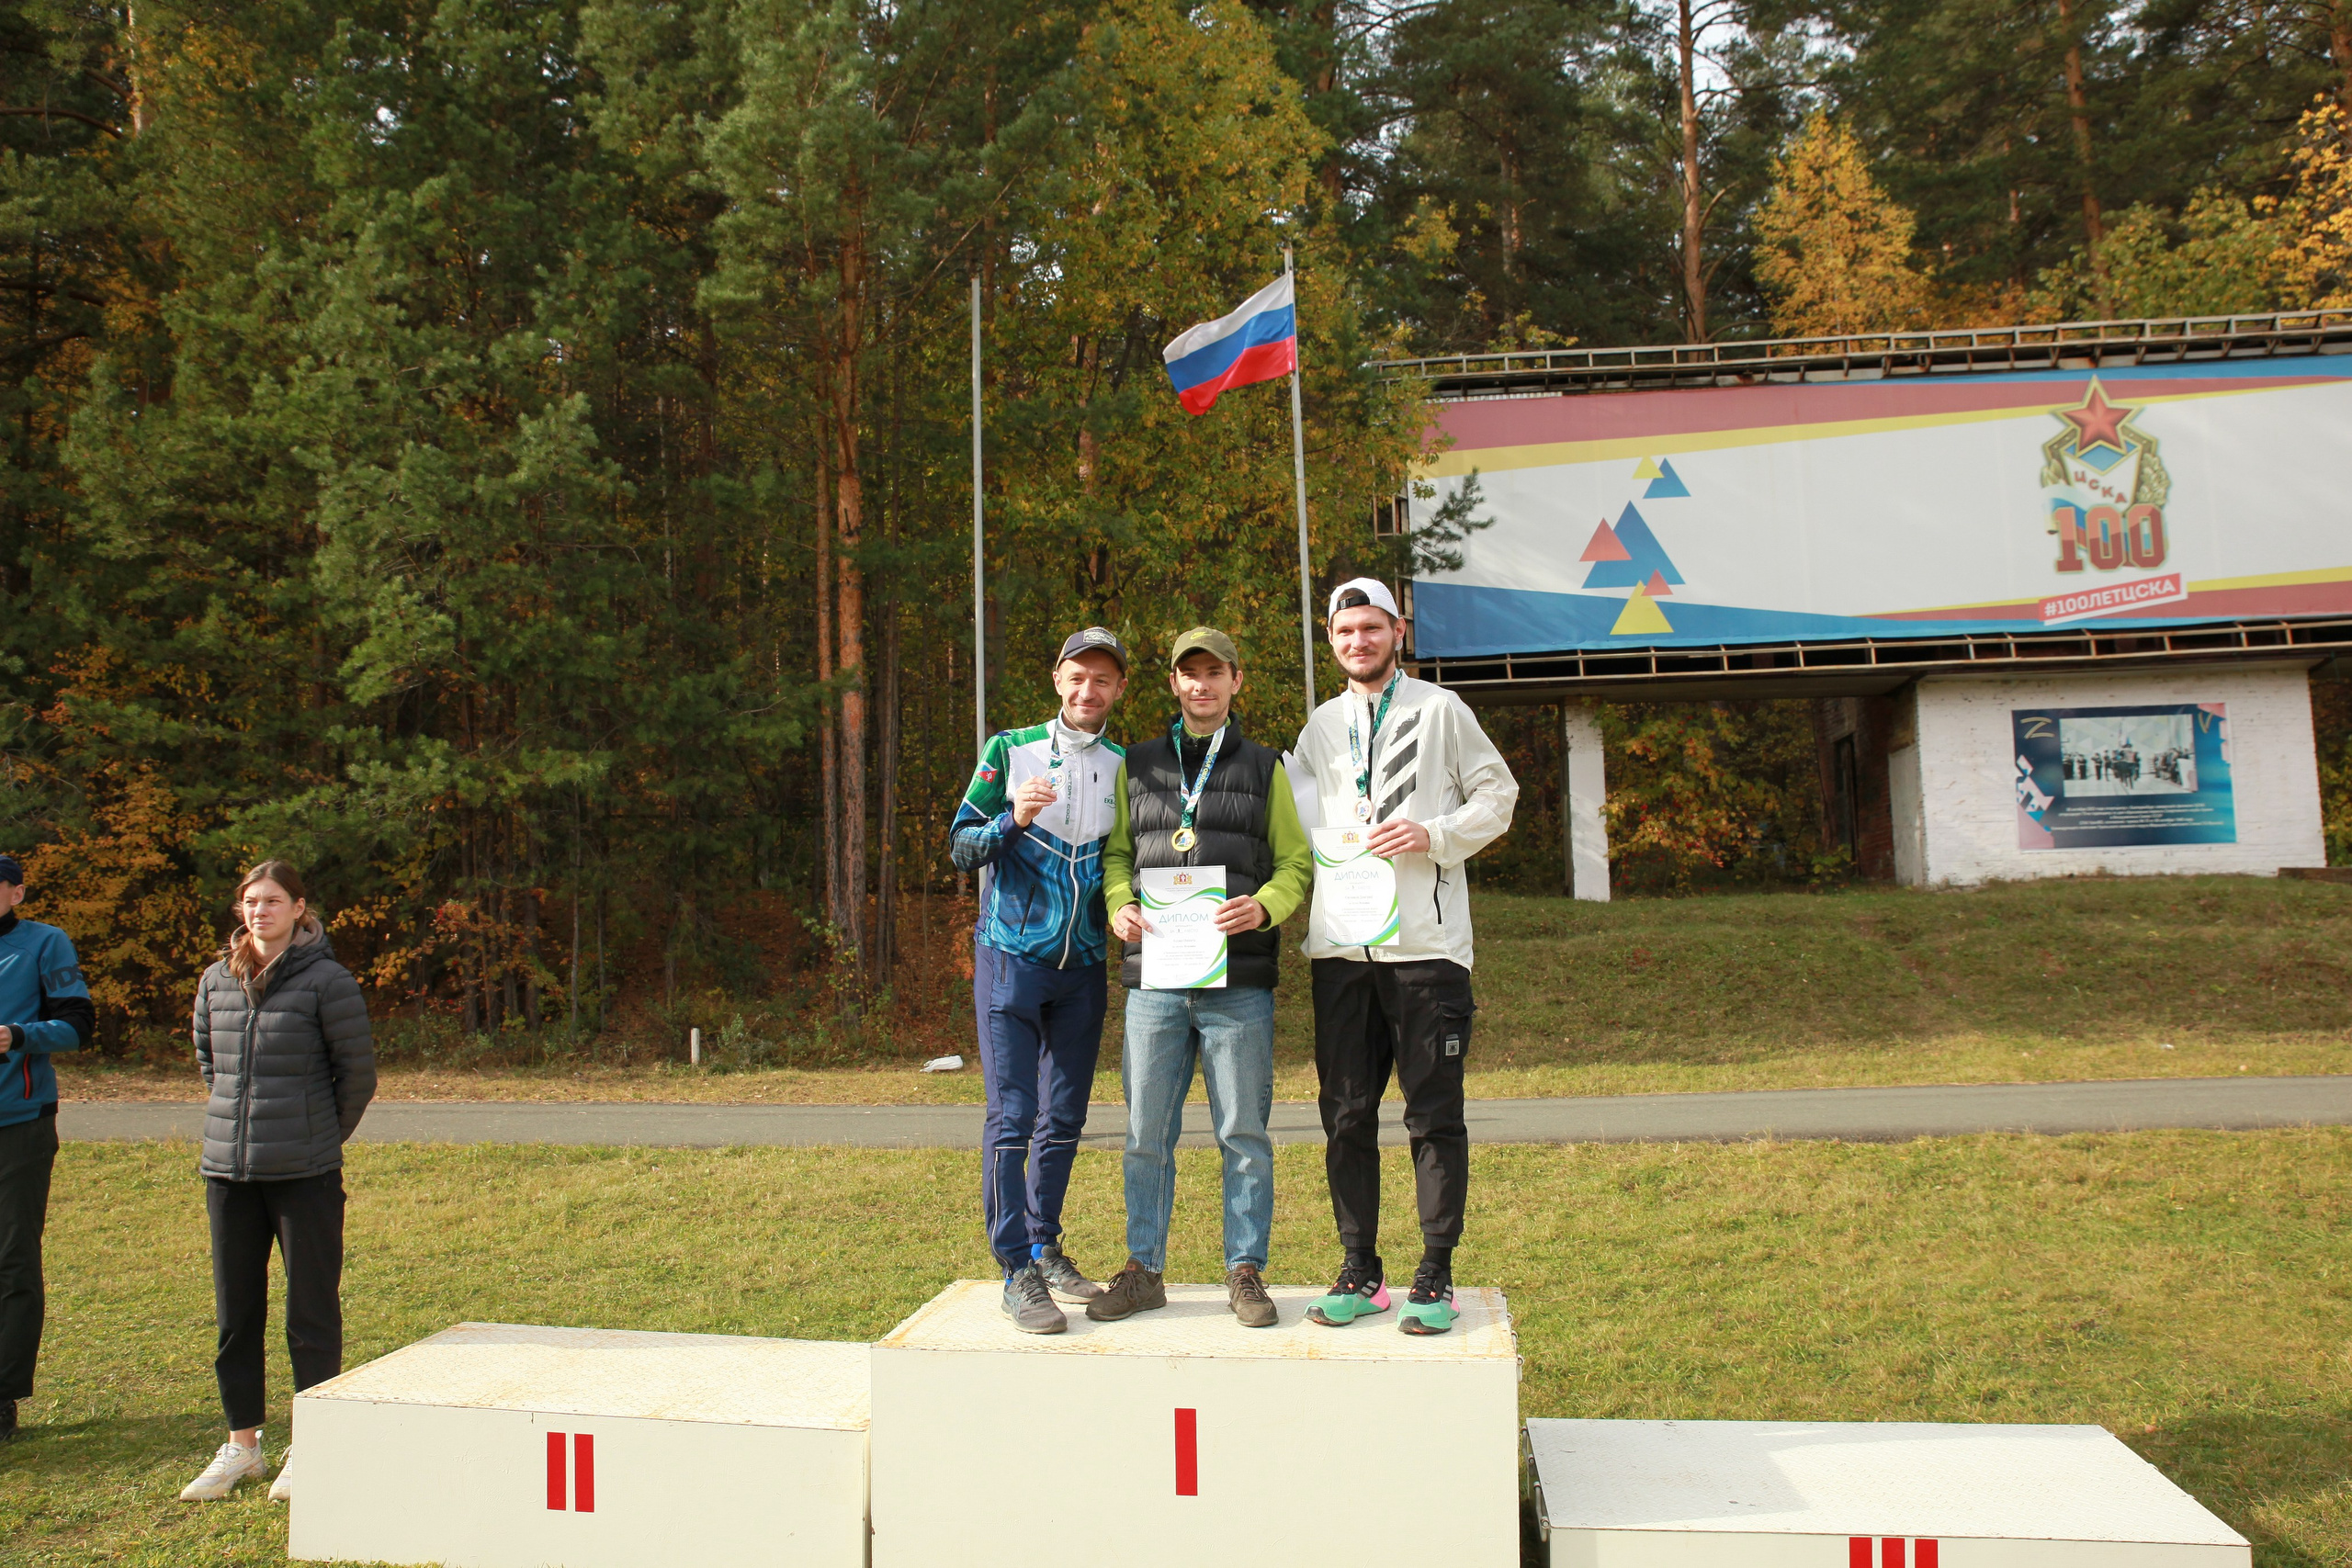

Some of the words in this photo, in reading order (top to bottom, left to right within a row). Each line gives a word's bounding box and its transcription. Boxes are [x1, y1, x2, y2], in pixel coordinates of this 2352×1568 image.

[2074, 470, 2128, 504] ЦСКА
[2053, 503, 2167, 573] 100
[2044, 579, 2177, 617] #100ЛЕТЦСКА
[2020, 716, 2055, 739] Z
[2198, 712, 2214, 734] V
[1334, 870, 1379, 881] ДИПЛОМ
[1159, 912, 1209, 924] ДИПЛОМ
[547, 1431, 594, 1513] II
